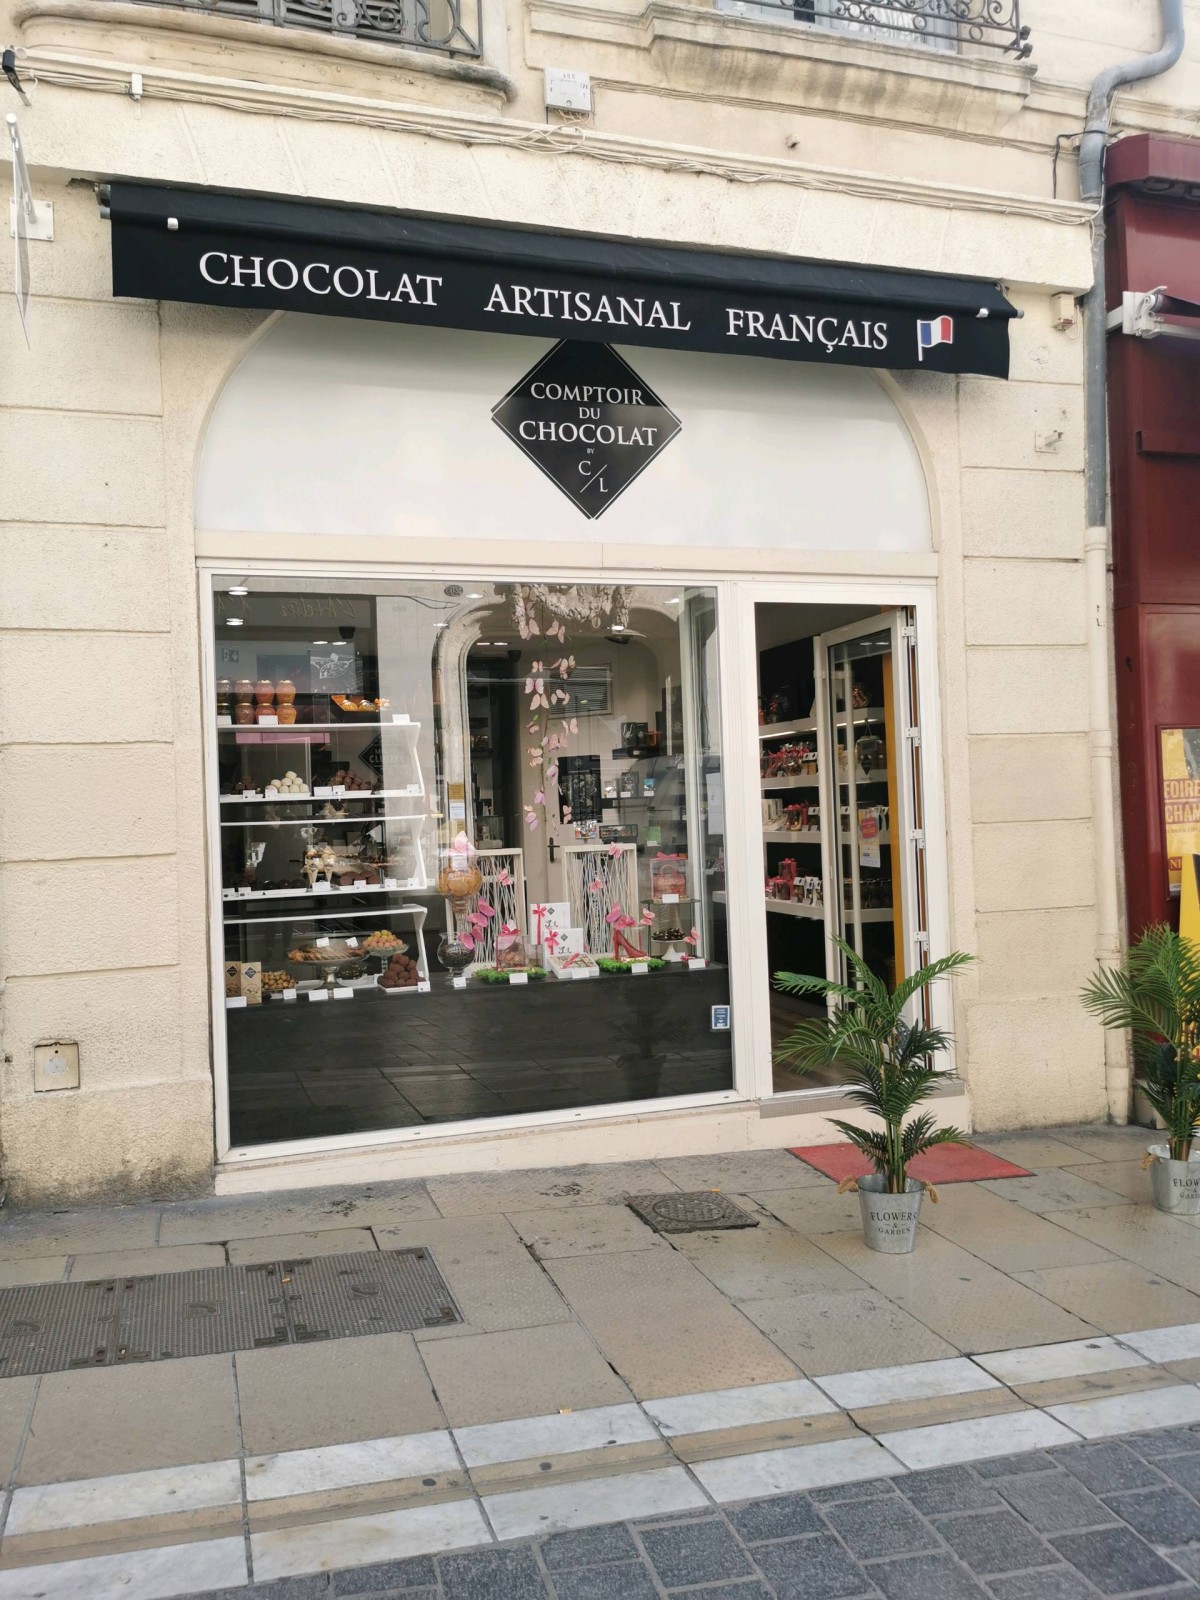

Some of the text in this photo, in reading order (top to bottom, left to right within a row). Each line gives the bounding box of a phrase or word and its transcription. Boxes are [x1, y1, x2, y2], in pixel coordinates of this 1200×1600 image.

[199, 252, 888, 353] CHOCOLAT ARTISANAL FRANÇAIS
[530, 382, 646, 405] COMPTOIR
[578, 407, 600, 419] DU
[519, 420, 657, 446] CHOCOLAT
[870, 1211, 917, 1221] FLOWERS
[878, 1227, 910, 1235] GARDEN
